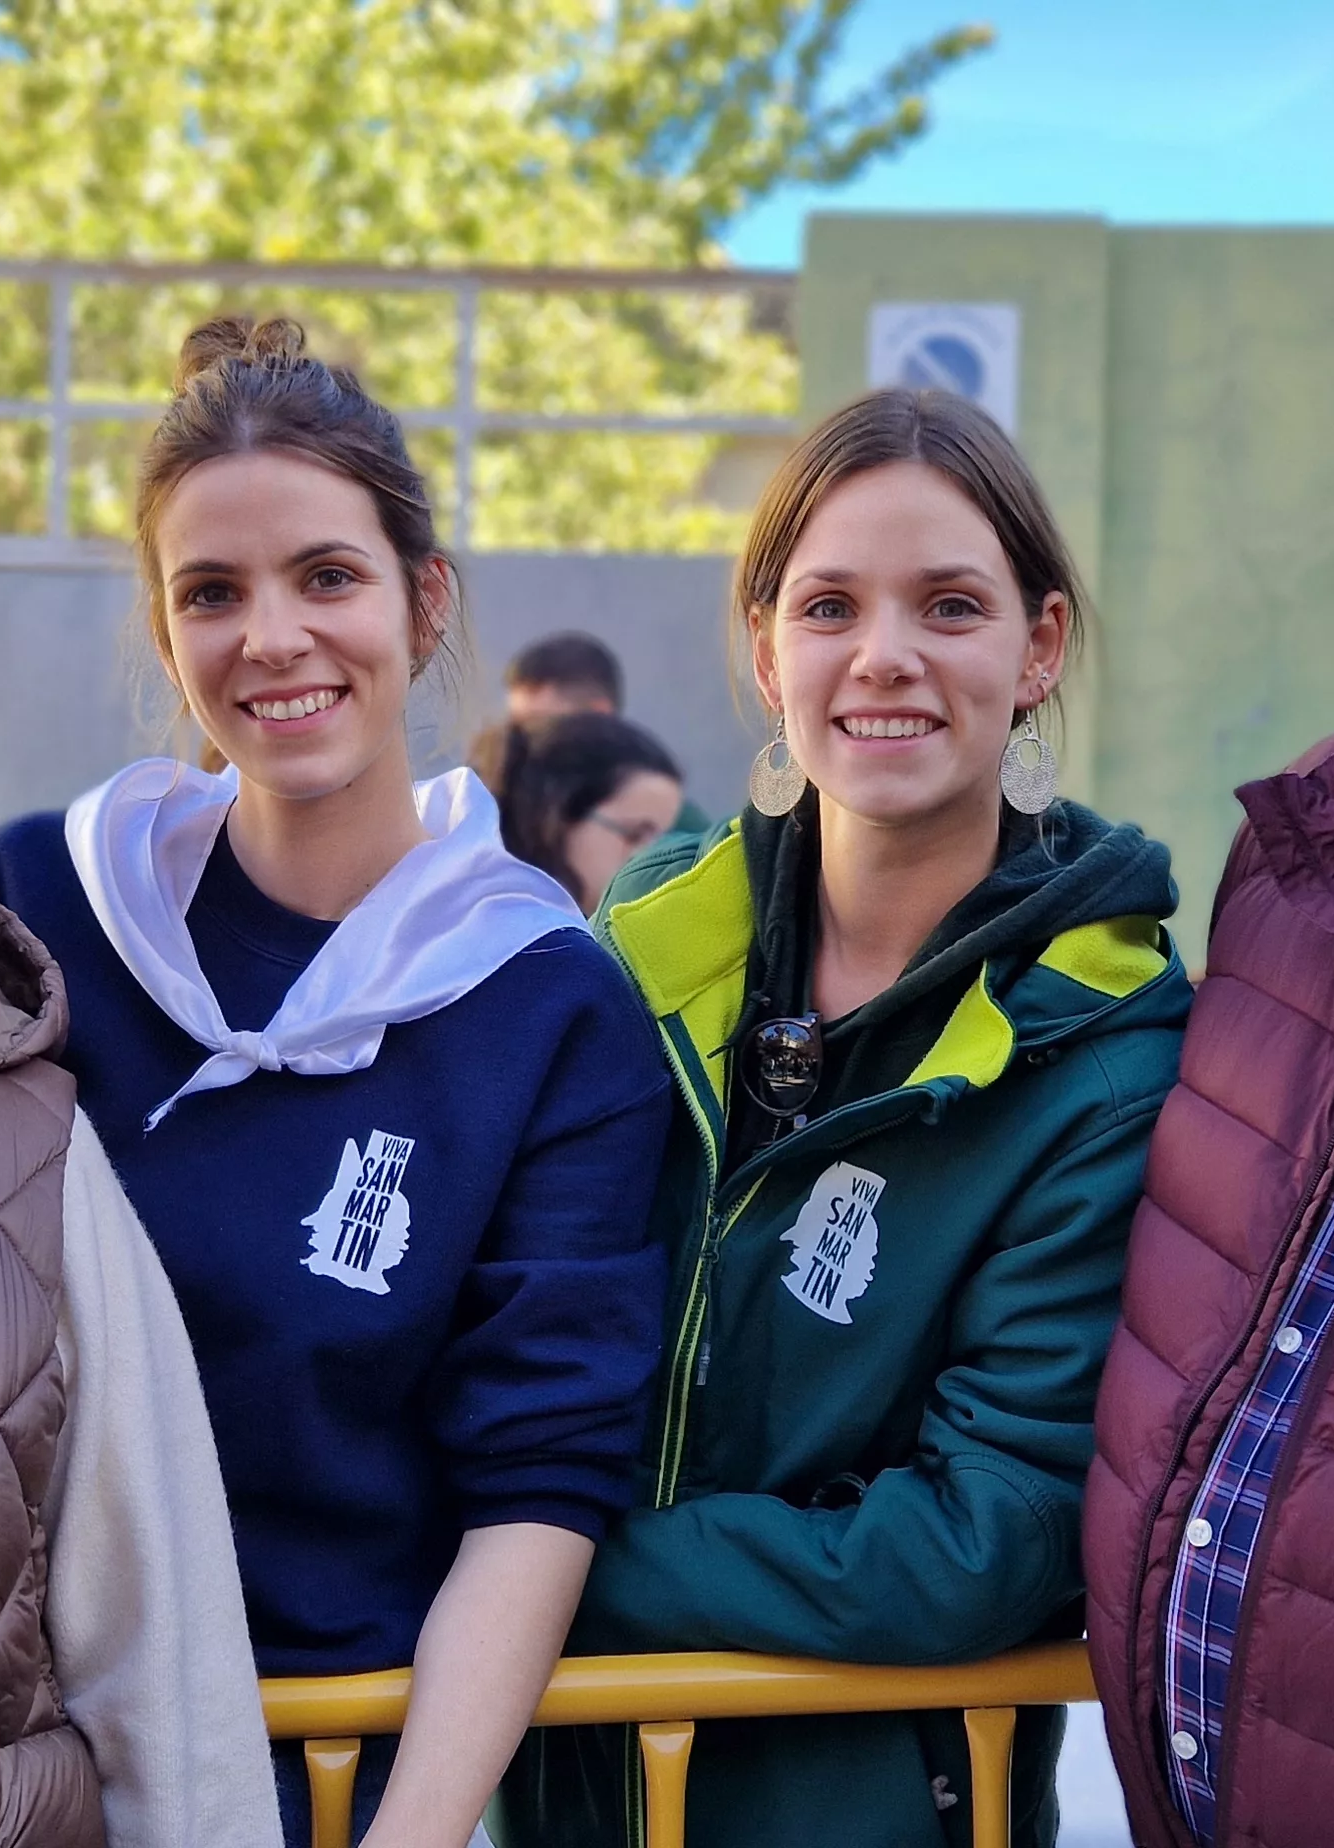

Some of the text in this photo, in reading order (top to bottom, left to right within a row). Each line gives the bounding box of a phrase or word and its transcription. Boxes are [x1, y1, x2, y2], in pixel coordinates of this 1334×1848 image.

[381, 1136, 410, 1161] VIVA
[356, 1157, 404, 1196] SAN
[851, 1177, 879, 1207] VIVA
[342, 1189, 391, 1228] MAR
[826, 1196, 868, 1240] SAN
[331, 1219, 381, 1272] TIN
[816, 1227, 852, 1270] MAR
[801, 1255, 842, 1310] TIN
